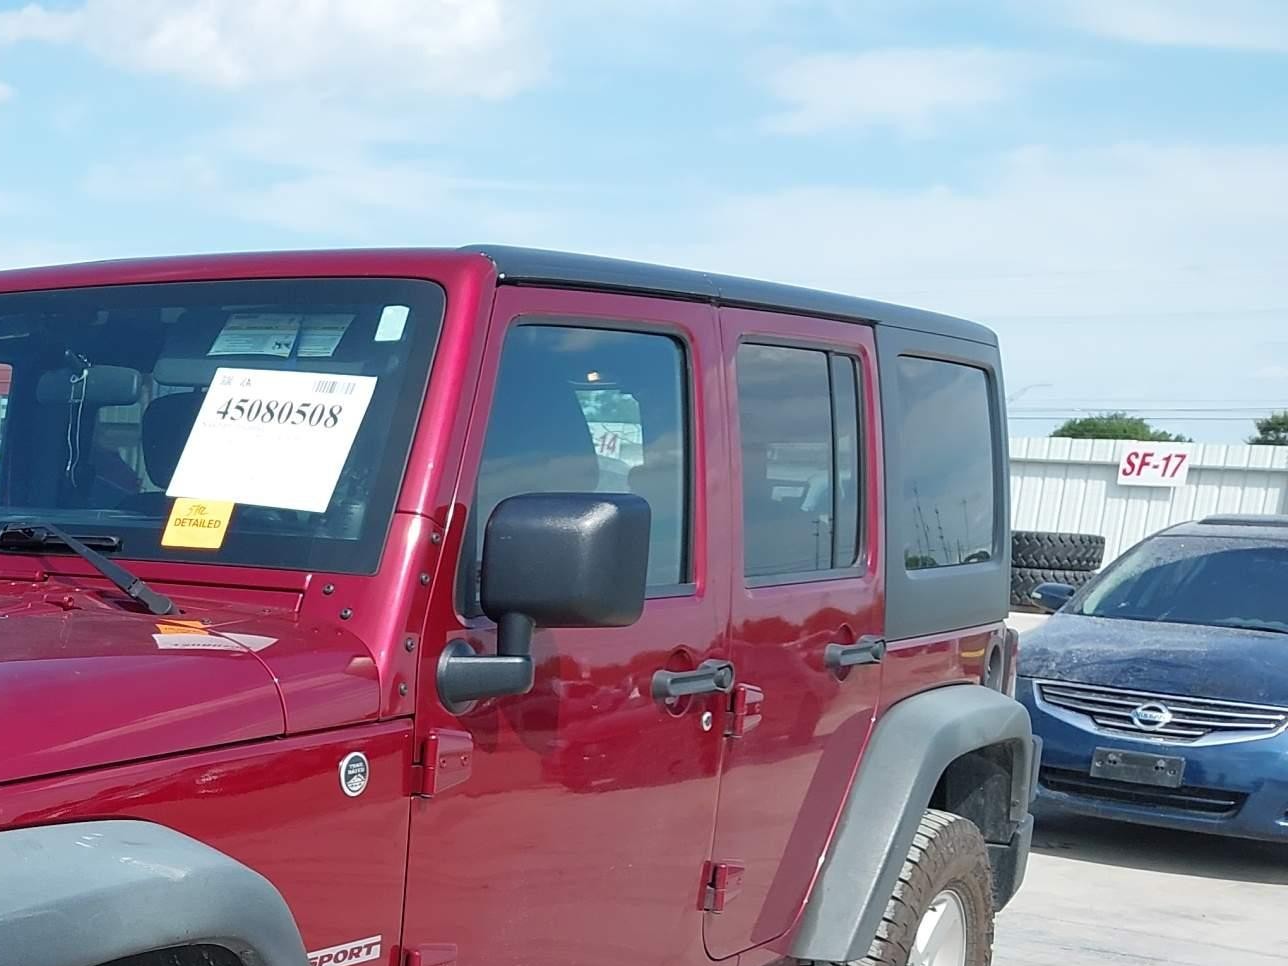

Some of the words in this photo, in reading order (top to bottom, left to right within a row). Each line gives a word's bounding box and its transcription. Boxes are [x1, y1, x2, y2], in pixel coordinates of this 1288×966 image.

[215, 397, 343, 428] 45080508
[1121, 451, 1187, 478] SF-17
[173, 517, 222, 529] DETAILED
